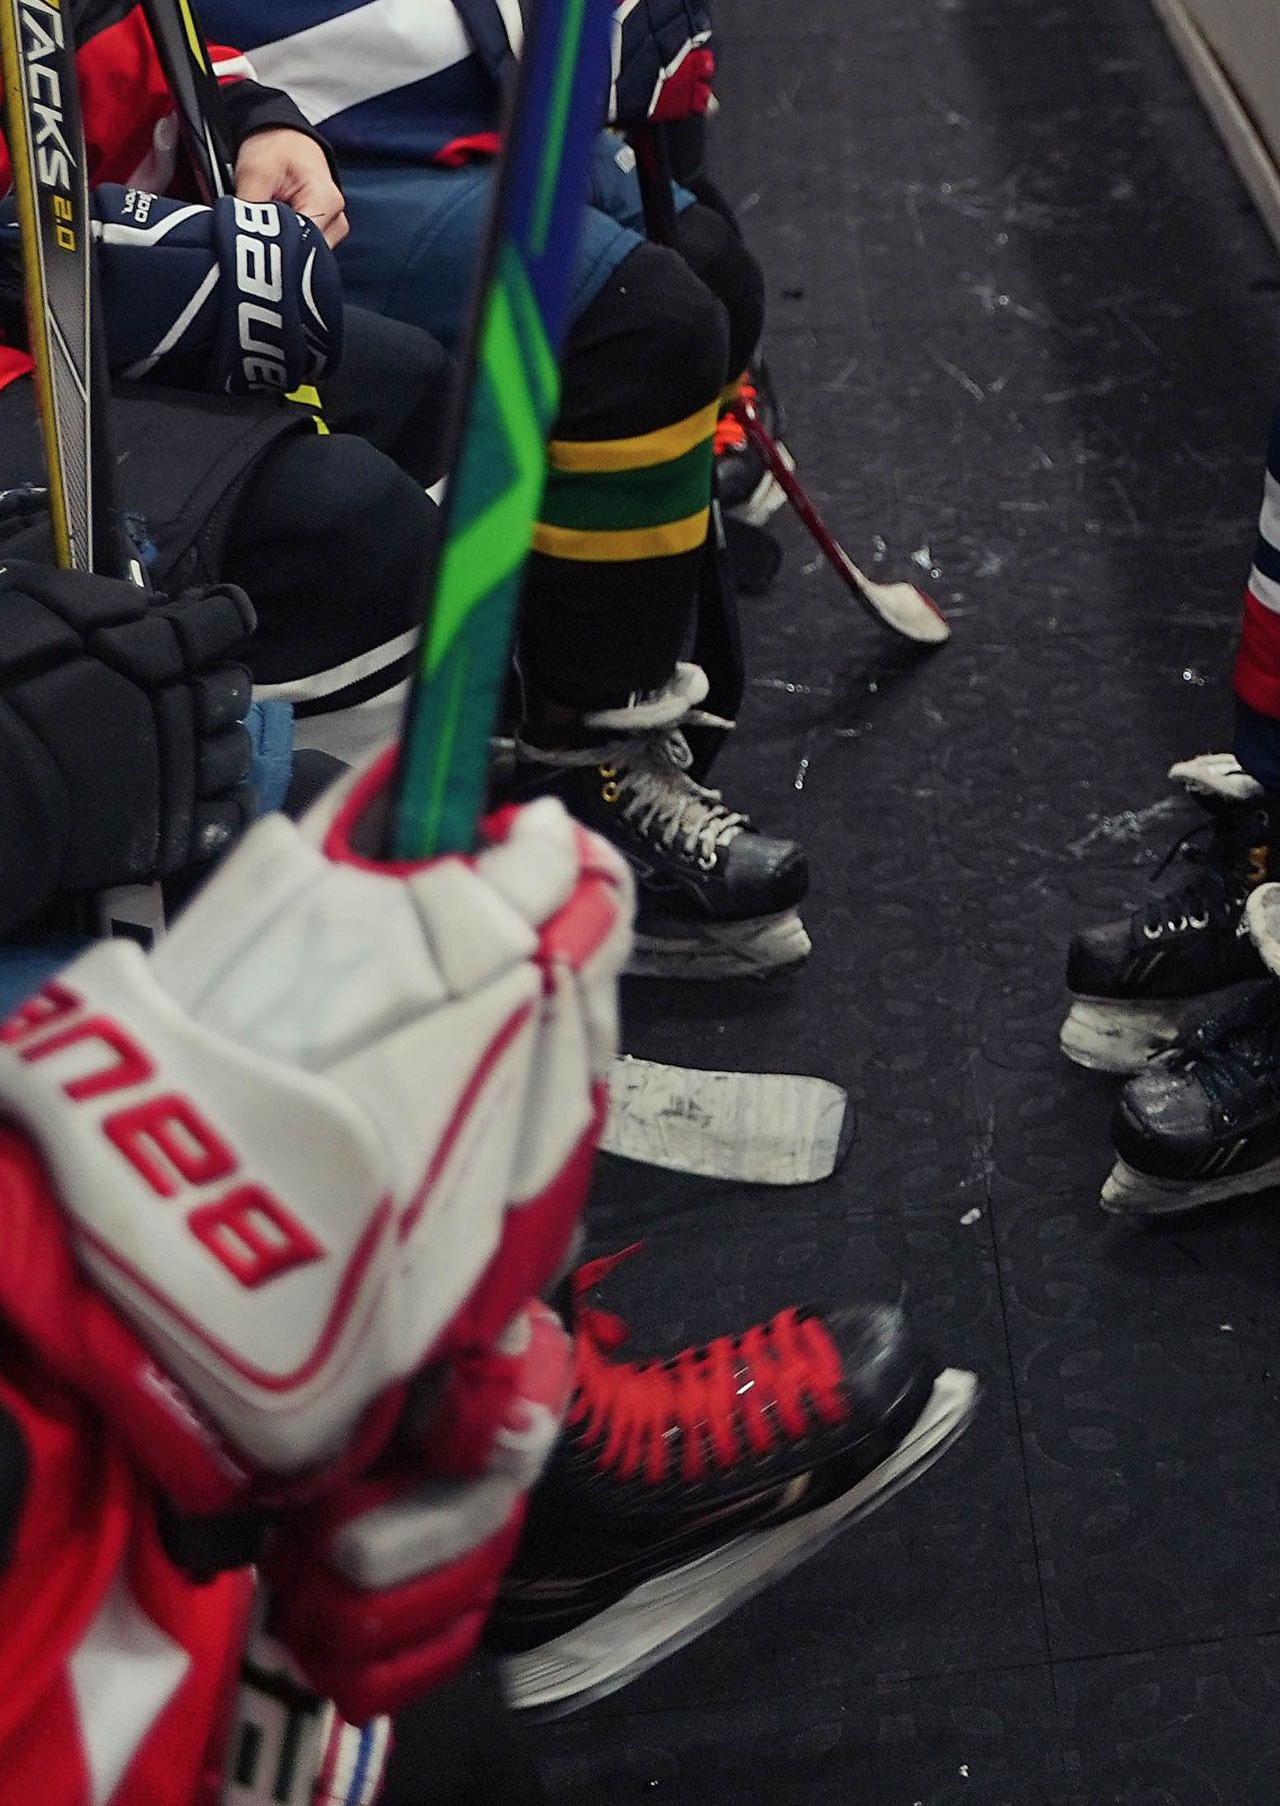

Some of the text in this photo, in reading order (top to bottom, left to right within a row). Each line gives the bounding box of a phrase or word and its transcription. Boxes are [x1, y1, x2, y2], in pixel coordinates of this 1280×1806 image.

[50, 194, 77, 253] 2.0
[232, 197, 289, 392] BAUE
[0, 978, 327, 1290] BAU
